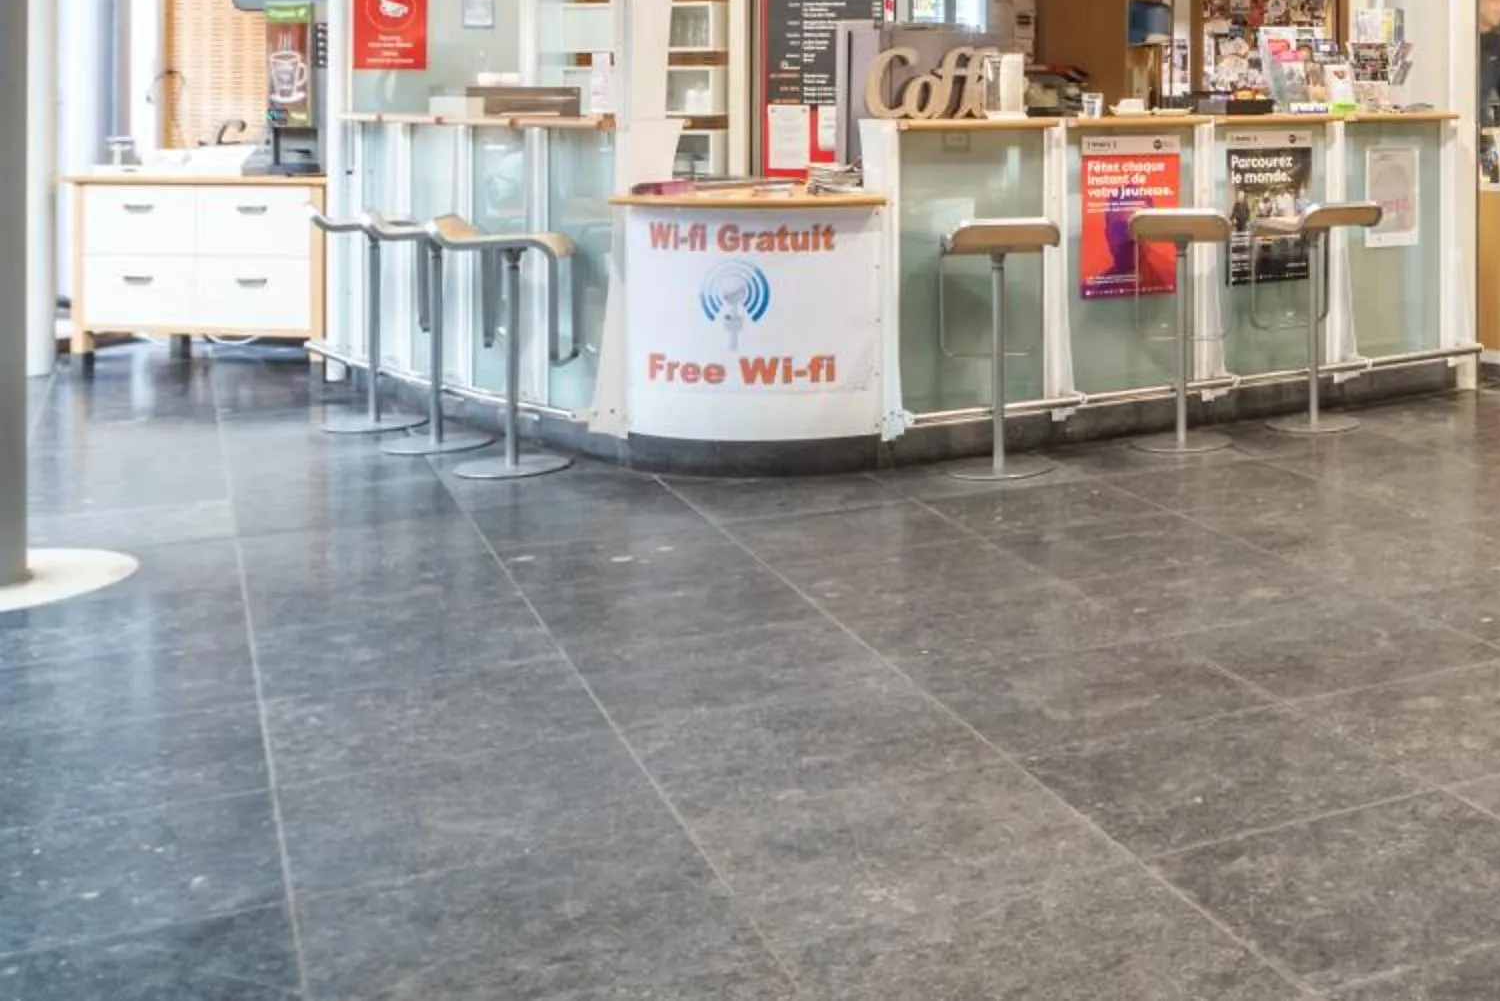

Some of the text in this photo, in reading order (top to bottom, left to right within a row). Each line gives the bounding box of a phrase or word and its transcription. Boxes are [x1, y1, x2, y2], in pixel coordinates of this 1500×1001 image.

[865, 46, 995, 119] Coff
[1231, 155, 1293, 169] Parcourez
[1231, 170, 1242, 184] le
[650, 221, 836, 253] Wi-fi Gratuit
[648, 353, 836, 385] Free Wi-fi
